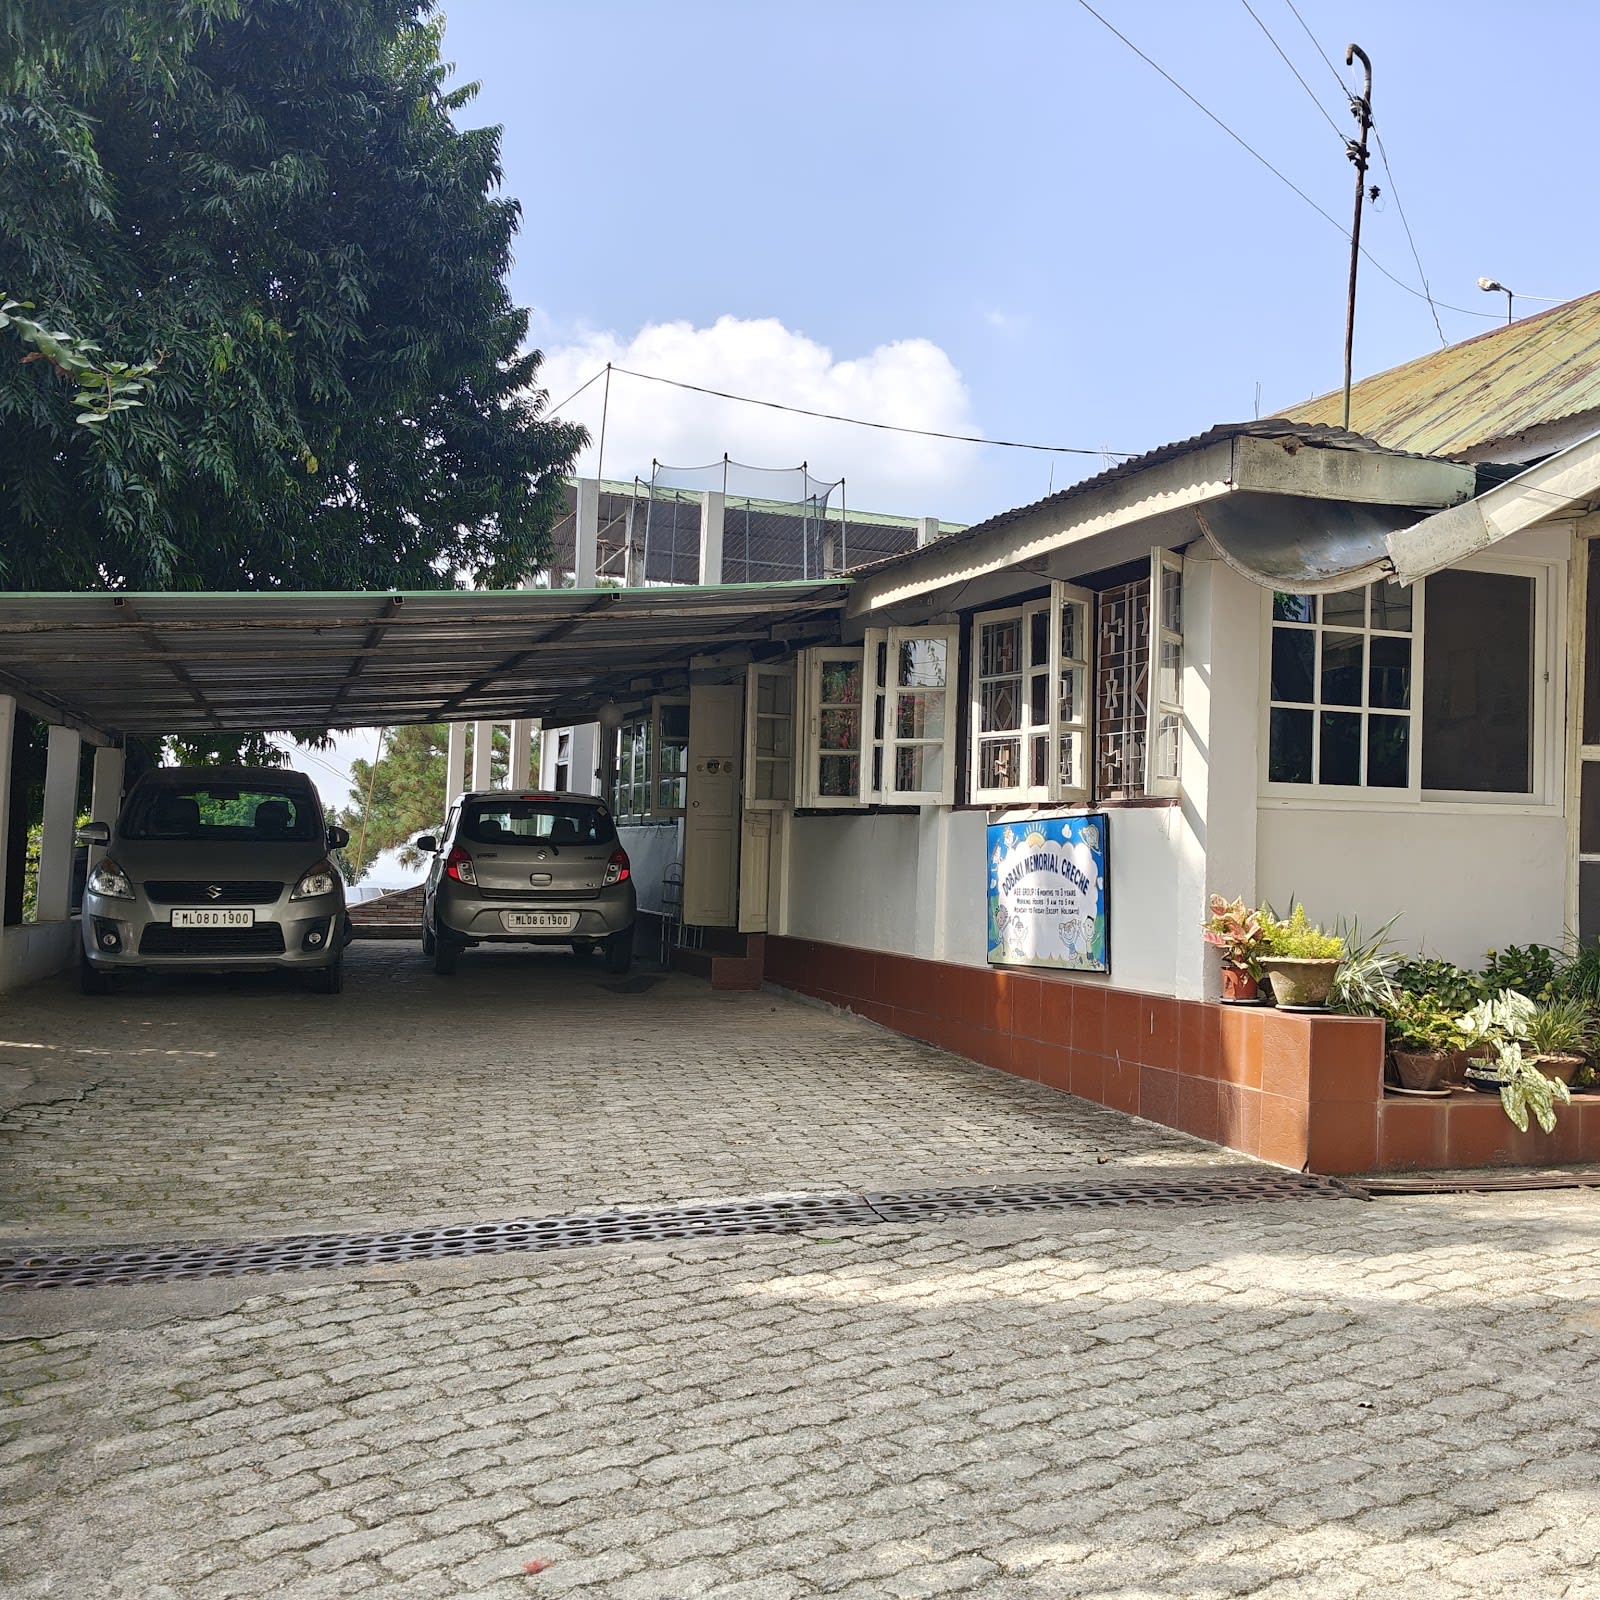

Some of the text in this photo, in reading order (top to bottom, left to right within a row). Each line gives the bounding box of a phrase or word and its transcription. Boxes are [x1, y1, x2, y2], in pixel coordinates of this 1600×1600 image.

[1002, 853, 1090, 897] DOBAKI MEMORIAL CRECHE
[182, 913, 249, 925] ML08 D 1900
[515, 915, 568, 925] ML08 G 1900
